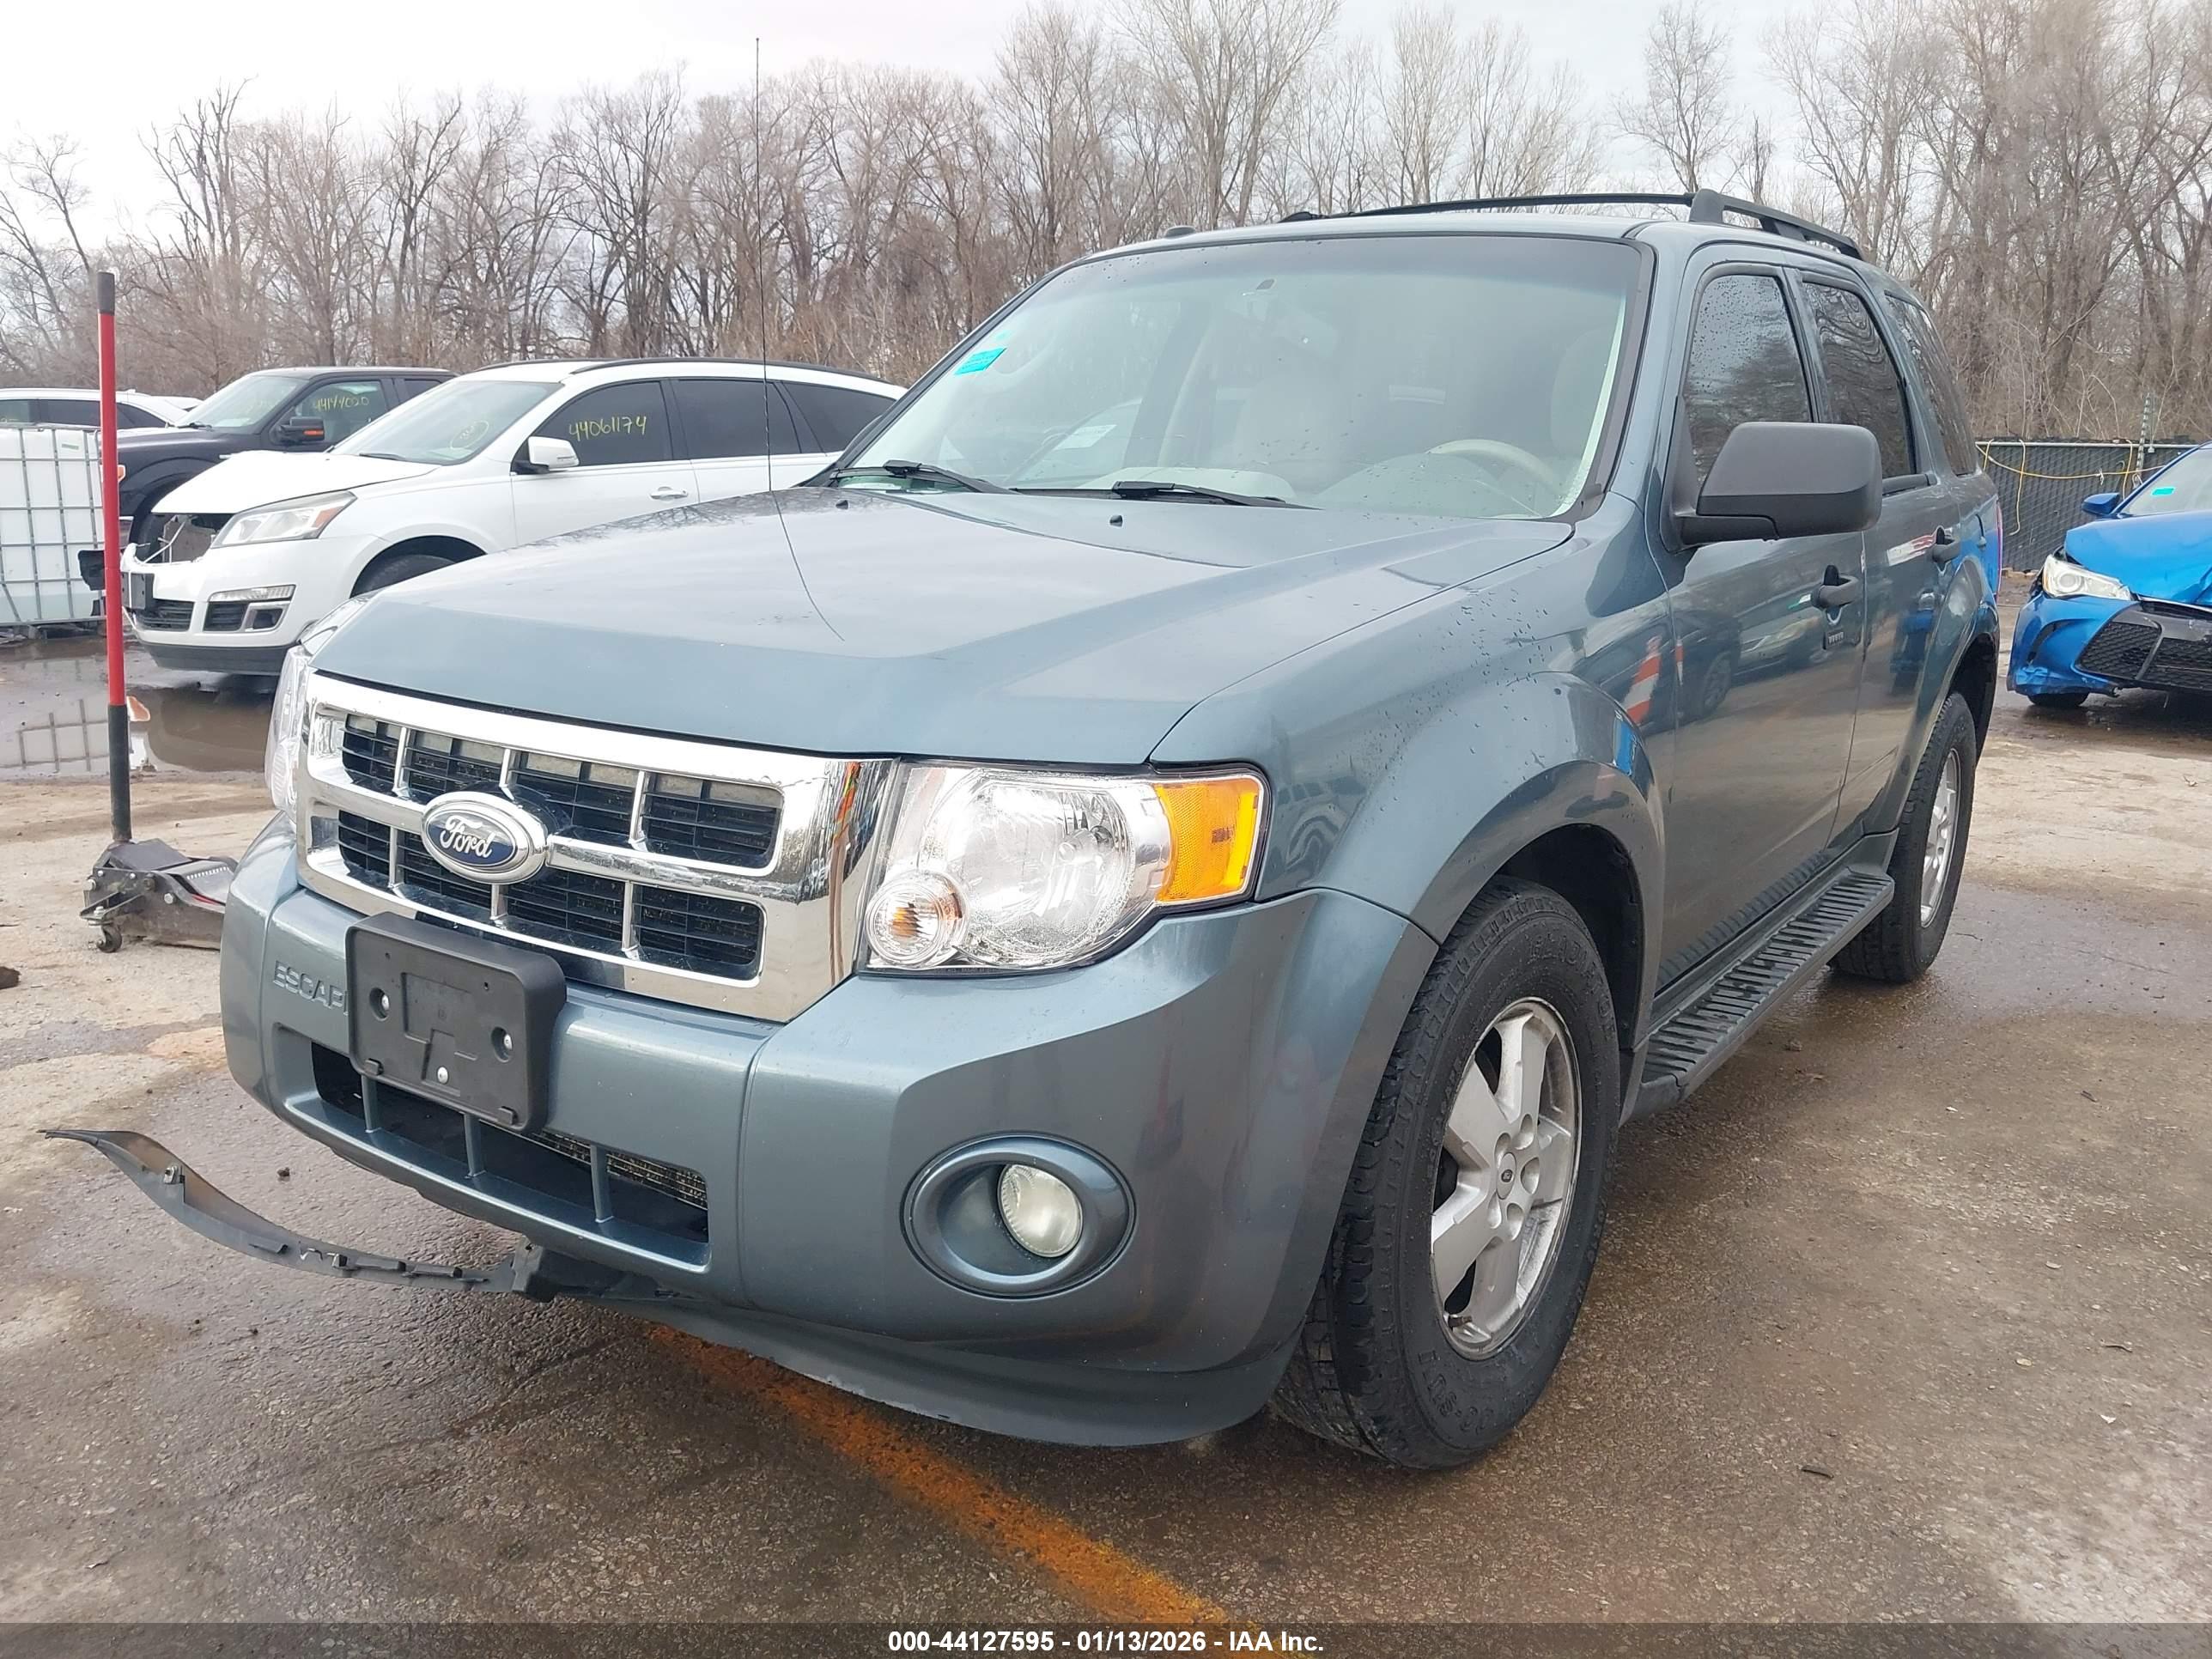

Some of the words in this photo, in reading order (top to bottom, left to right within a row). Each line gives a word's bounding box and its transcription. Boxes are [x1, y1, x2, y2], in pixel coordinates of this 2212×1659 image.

[568, 416, 647, 441] 44061174
[440, 815, 495, 858] Ford
[273, 960, 349, 1016] ESCAP
